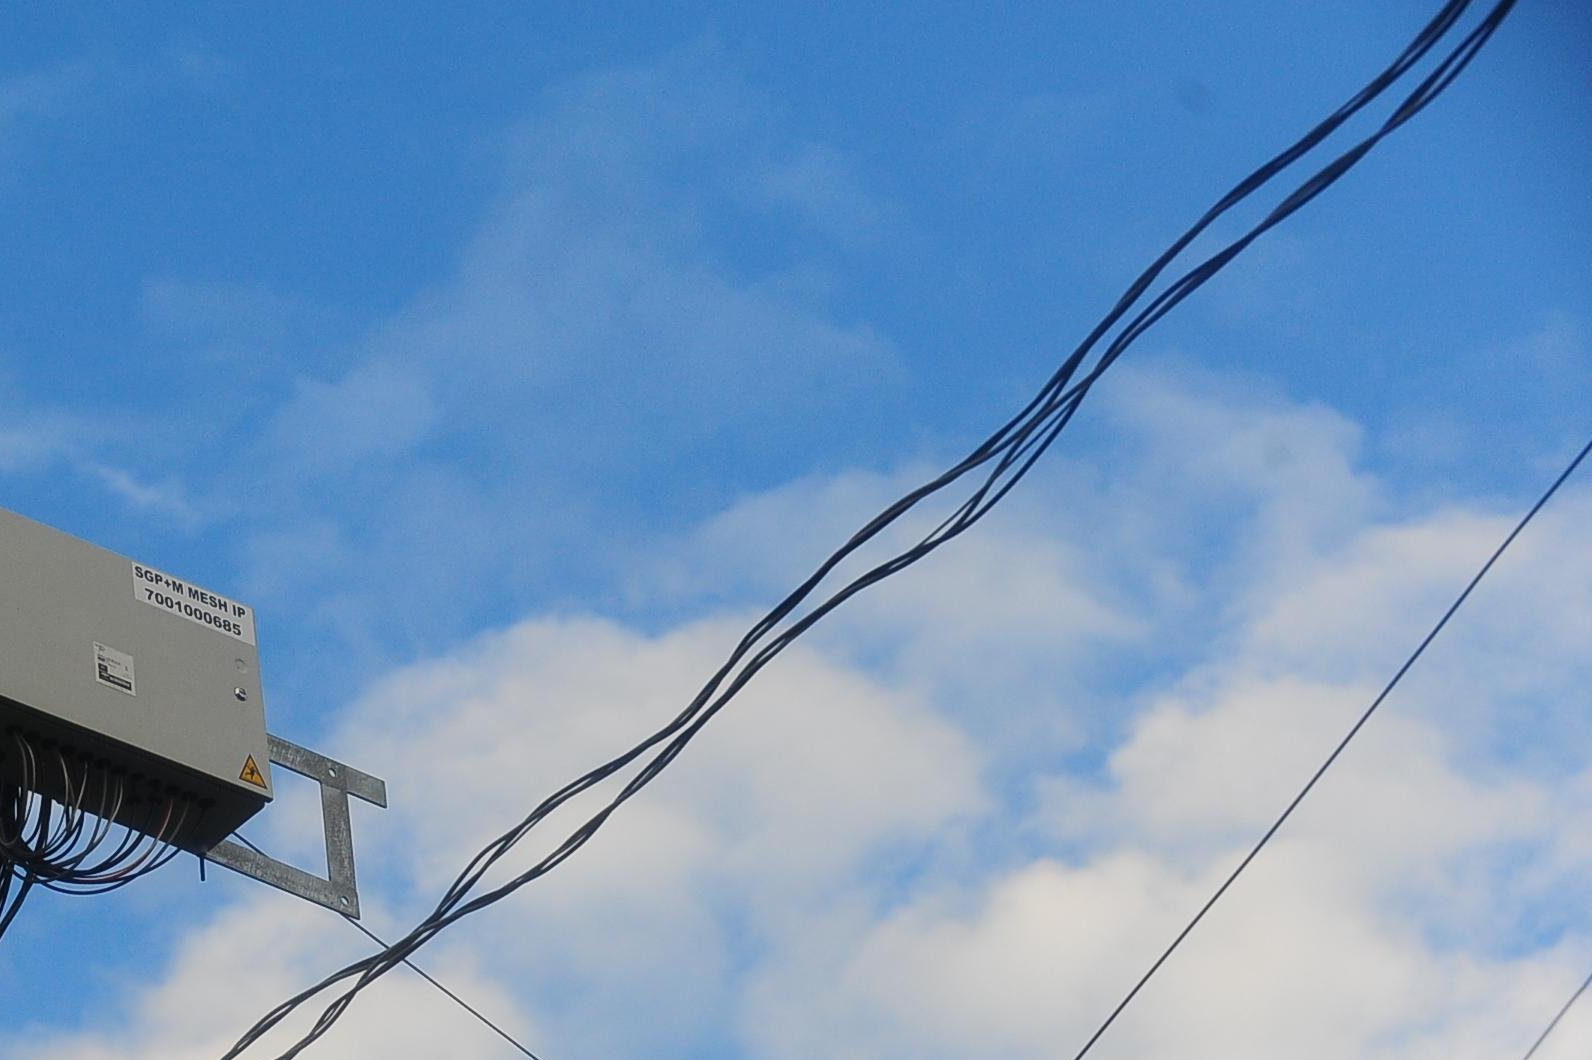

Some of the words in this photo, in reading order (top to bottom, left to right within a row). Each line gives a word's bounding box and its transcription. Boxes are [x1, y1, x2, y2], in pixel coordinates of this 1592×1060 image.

[134, 566, 184, 595] SGP+M
[187, 586, 228, 612] MESH
[232, 604, 246, 618] IP
[145, 587, 242, 636] 7001000685
